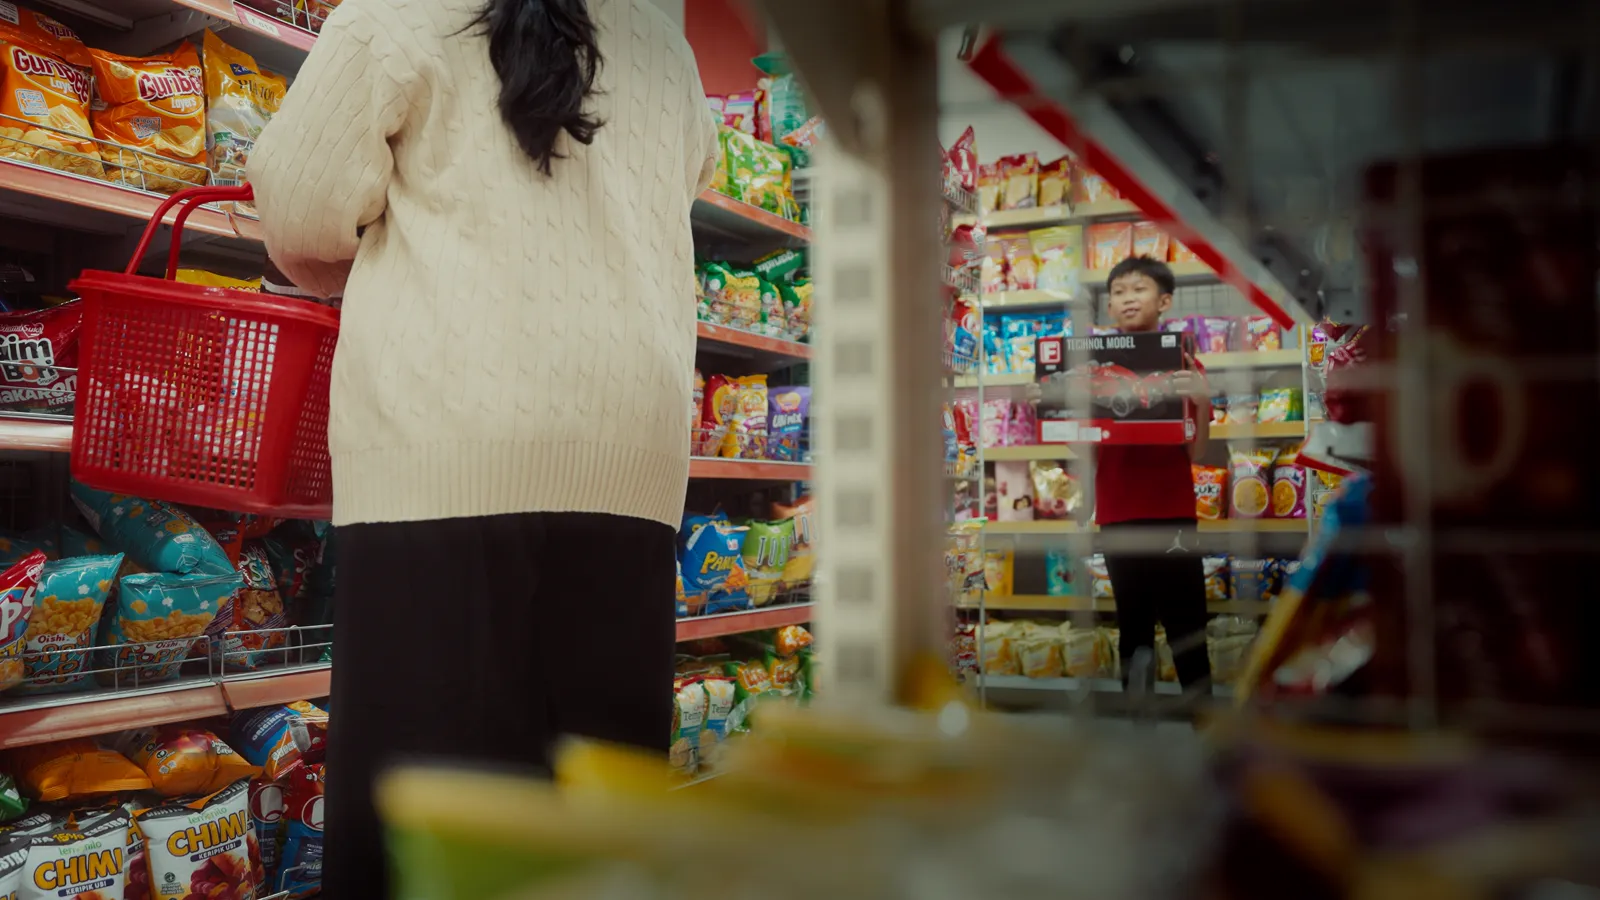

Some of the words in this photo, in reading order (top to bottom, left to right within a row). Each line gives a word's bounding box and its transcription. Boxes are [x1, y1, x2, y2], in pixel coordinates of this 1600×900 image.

[1107, 336, 1135, 349] MODEL
[38, 633, 66, 644] Oishi
[155, 640, 179, 649] Oishi
[252, 711, 286, 741] ORIGINAL
[167, 810, 247, 857] CHIMI
[58, 841, 102, 856] lemnilo
[198, 847, 225, 860] KERIPIK
[226, 842, 237, 853] UBI
[34, 847, 123, 890] CHIMI
[65, 884, 94, 896] KERIPIK
[95, 880, 107, 890] UBI
